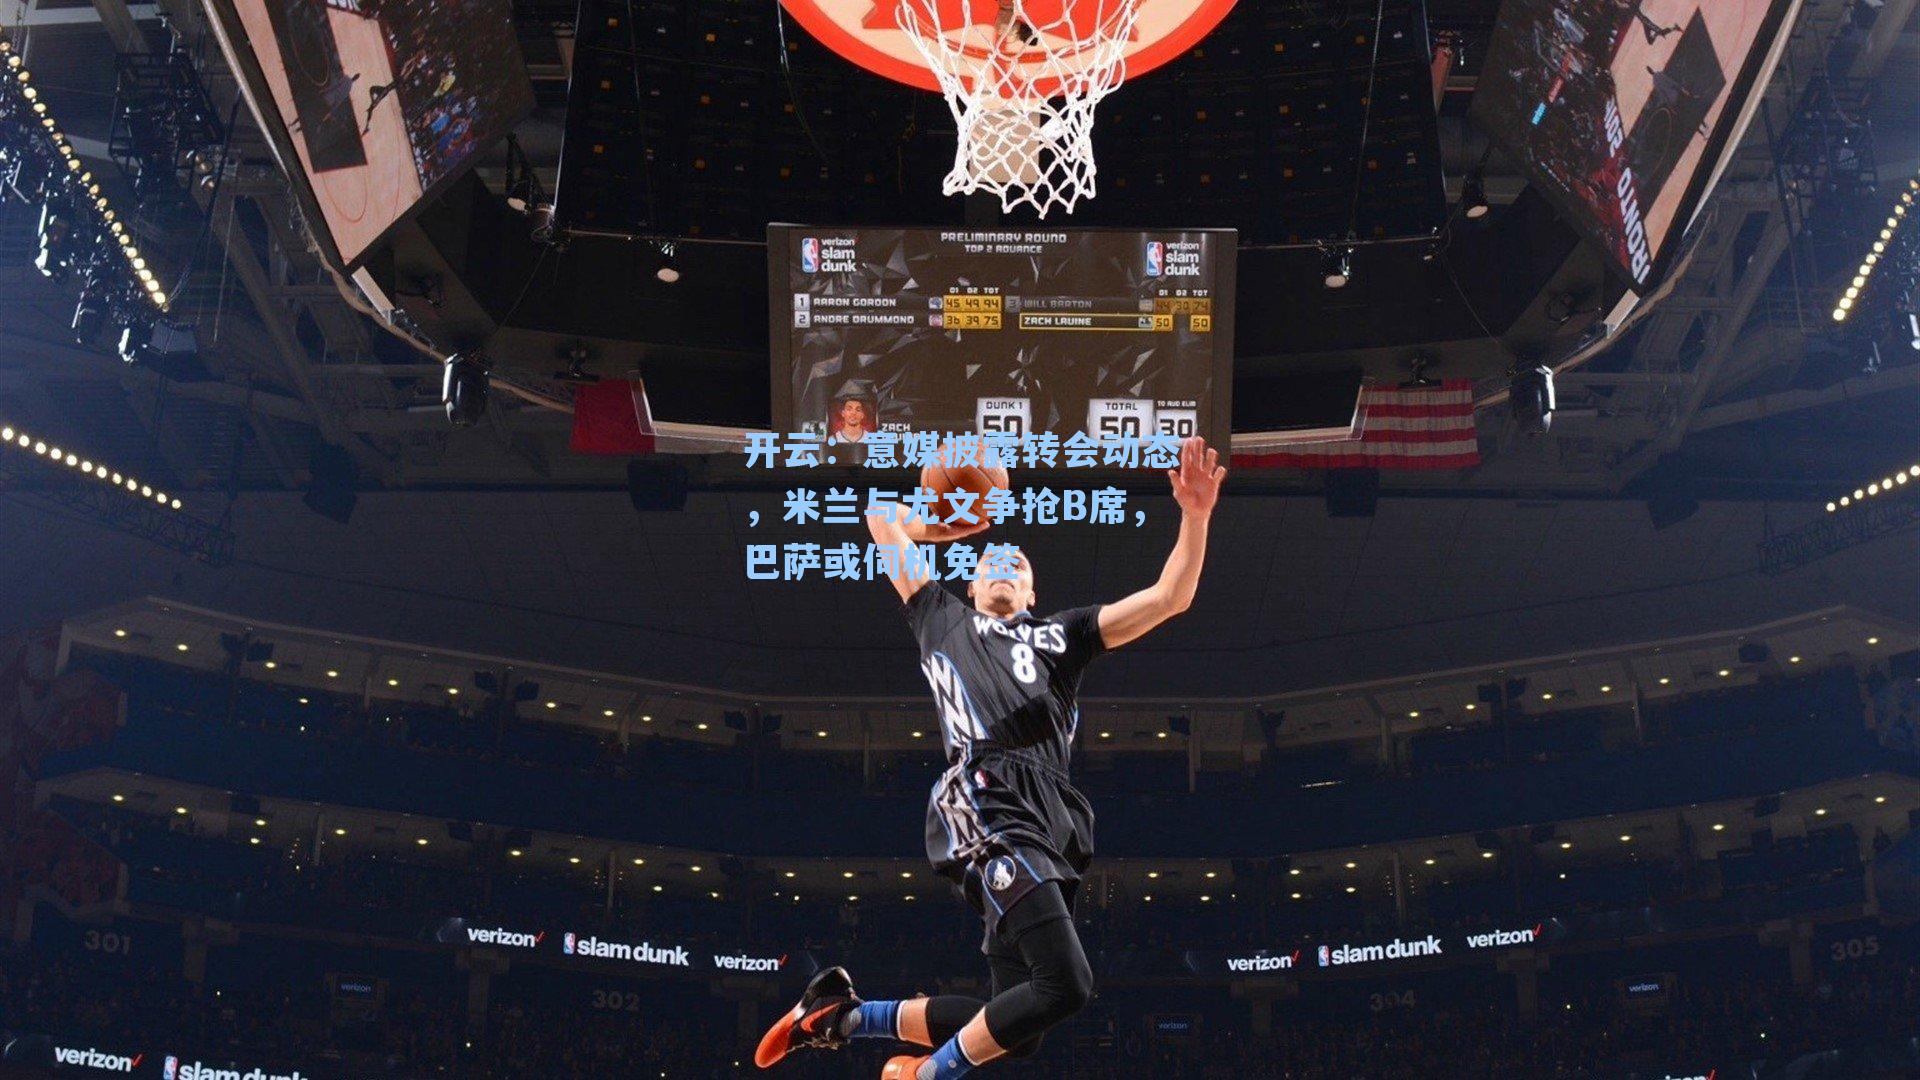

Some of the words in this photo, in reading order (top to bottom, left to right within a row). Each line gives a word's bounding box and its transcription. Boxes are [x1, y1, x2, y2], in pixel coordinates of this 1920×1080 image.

[821, 238, 855, 247] verizon
[940, 233, 1021, 243] PRELIMINARY
[1025, 233, 1067, 244] ROUND
[964, 245, 984, 254] TOP
[986, 245, 993, 254] 2
[1165, 242, 1200, 251] verizon
[821, 247, 856, 260] slam
[1165, 250, 1200, 264] slam
[821, 260, 857, 272] dunk
[1164, 263, 1200, 276] dunk
[813, 298, 850, 307] AARON
[853, 298, 897, 307] GORDON
[947, 299, 960, 308] 45
[966, 299, 980, 308] 49
[984, 299, 999, 308] 94
[799, 315, 806, 325] 2
[813, 315, 850, 324] ANDRE
[852, 315, 915, 325] DRUMMOND
[966, 315, 980, 325] 39
[984, 315, 999, 325] 75
[1024, 317, 1053, 326] ZACH
[1156, 318, 1170, 327] 50
[1193, 318, 1208, 327] 50
[985, 401, 1017, 410] DUNK
[1105, 402, 1138, 411] TOTAL
[881, 423, 911, 432] ZACH
[983, 415, 1023, 439] 50
[1100, 416, 1140, 440] 50
[1160, 419, 1193, 438] 30
[973, 615, 1067, 654] WOLVES
[1011, 642, 1037, 684] 8
[467, 928, 536, 948] verizon
[1466, 929, 1535, 949] verizon
[577, 936, 631, 960] slam
[632, 942, 690, 967] dunk
[1331, 945, 1384, 965] slam
[1385, 935, 1442, 960] dunk
[713, 953, 780, 971] verizon
[1227, 953, 1293, 971] verizon
[1628, 983, 1660, 992] verizon
[54, 1046, 133, 1073] verizon
